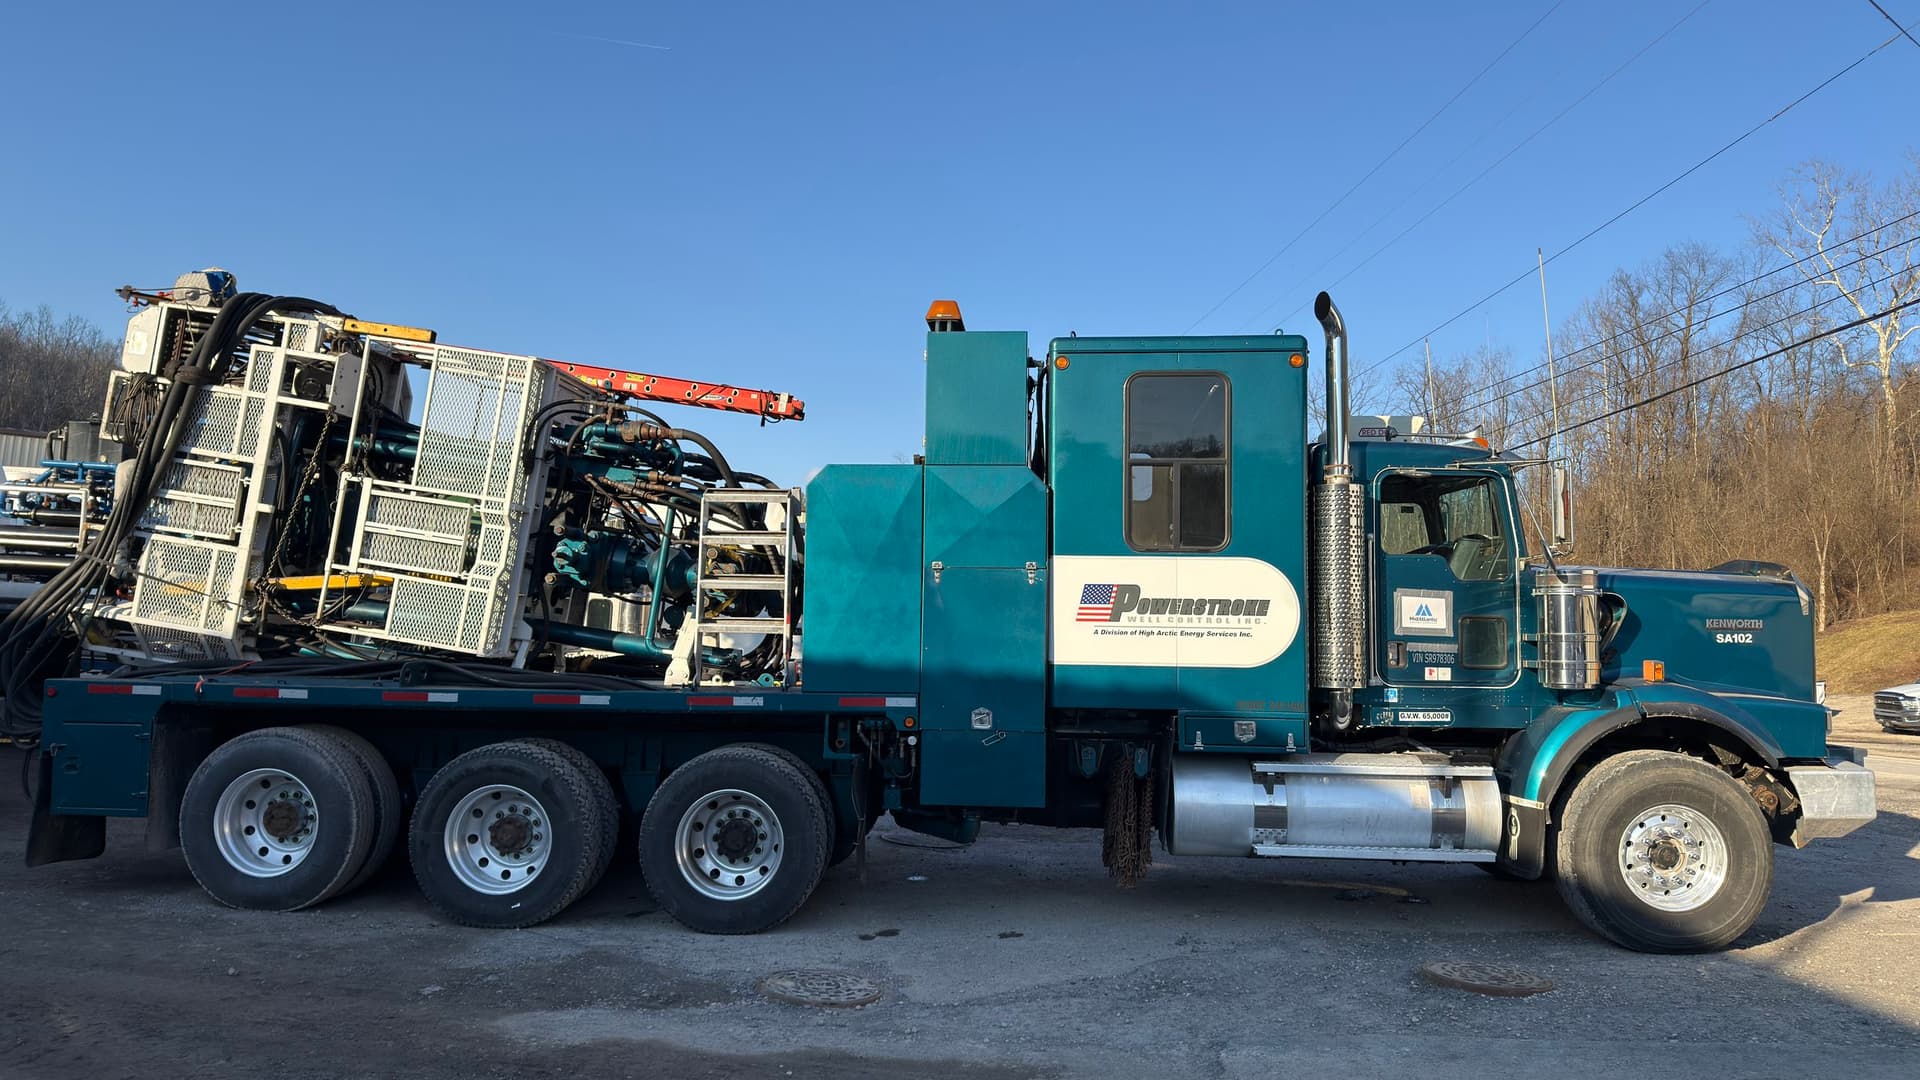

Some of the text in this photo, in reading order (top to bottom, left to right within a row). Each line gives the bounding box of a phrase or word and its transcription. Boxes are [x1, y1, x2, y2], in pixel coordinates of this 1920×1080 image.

[1167, 616, 1231, 624] CONTROL
[1237, 617, 1268, 625] INC.
[1705, 618, 1763, 629] KENWORTH
[1716, 633, 1753, 643] SA102
[1412, 652, 1424, 663] VIN
[1399, 712, 1421, 720] G.V.W.
